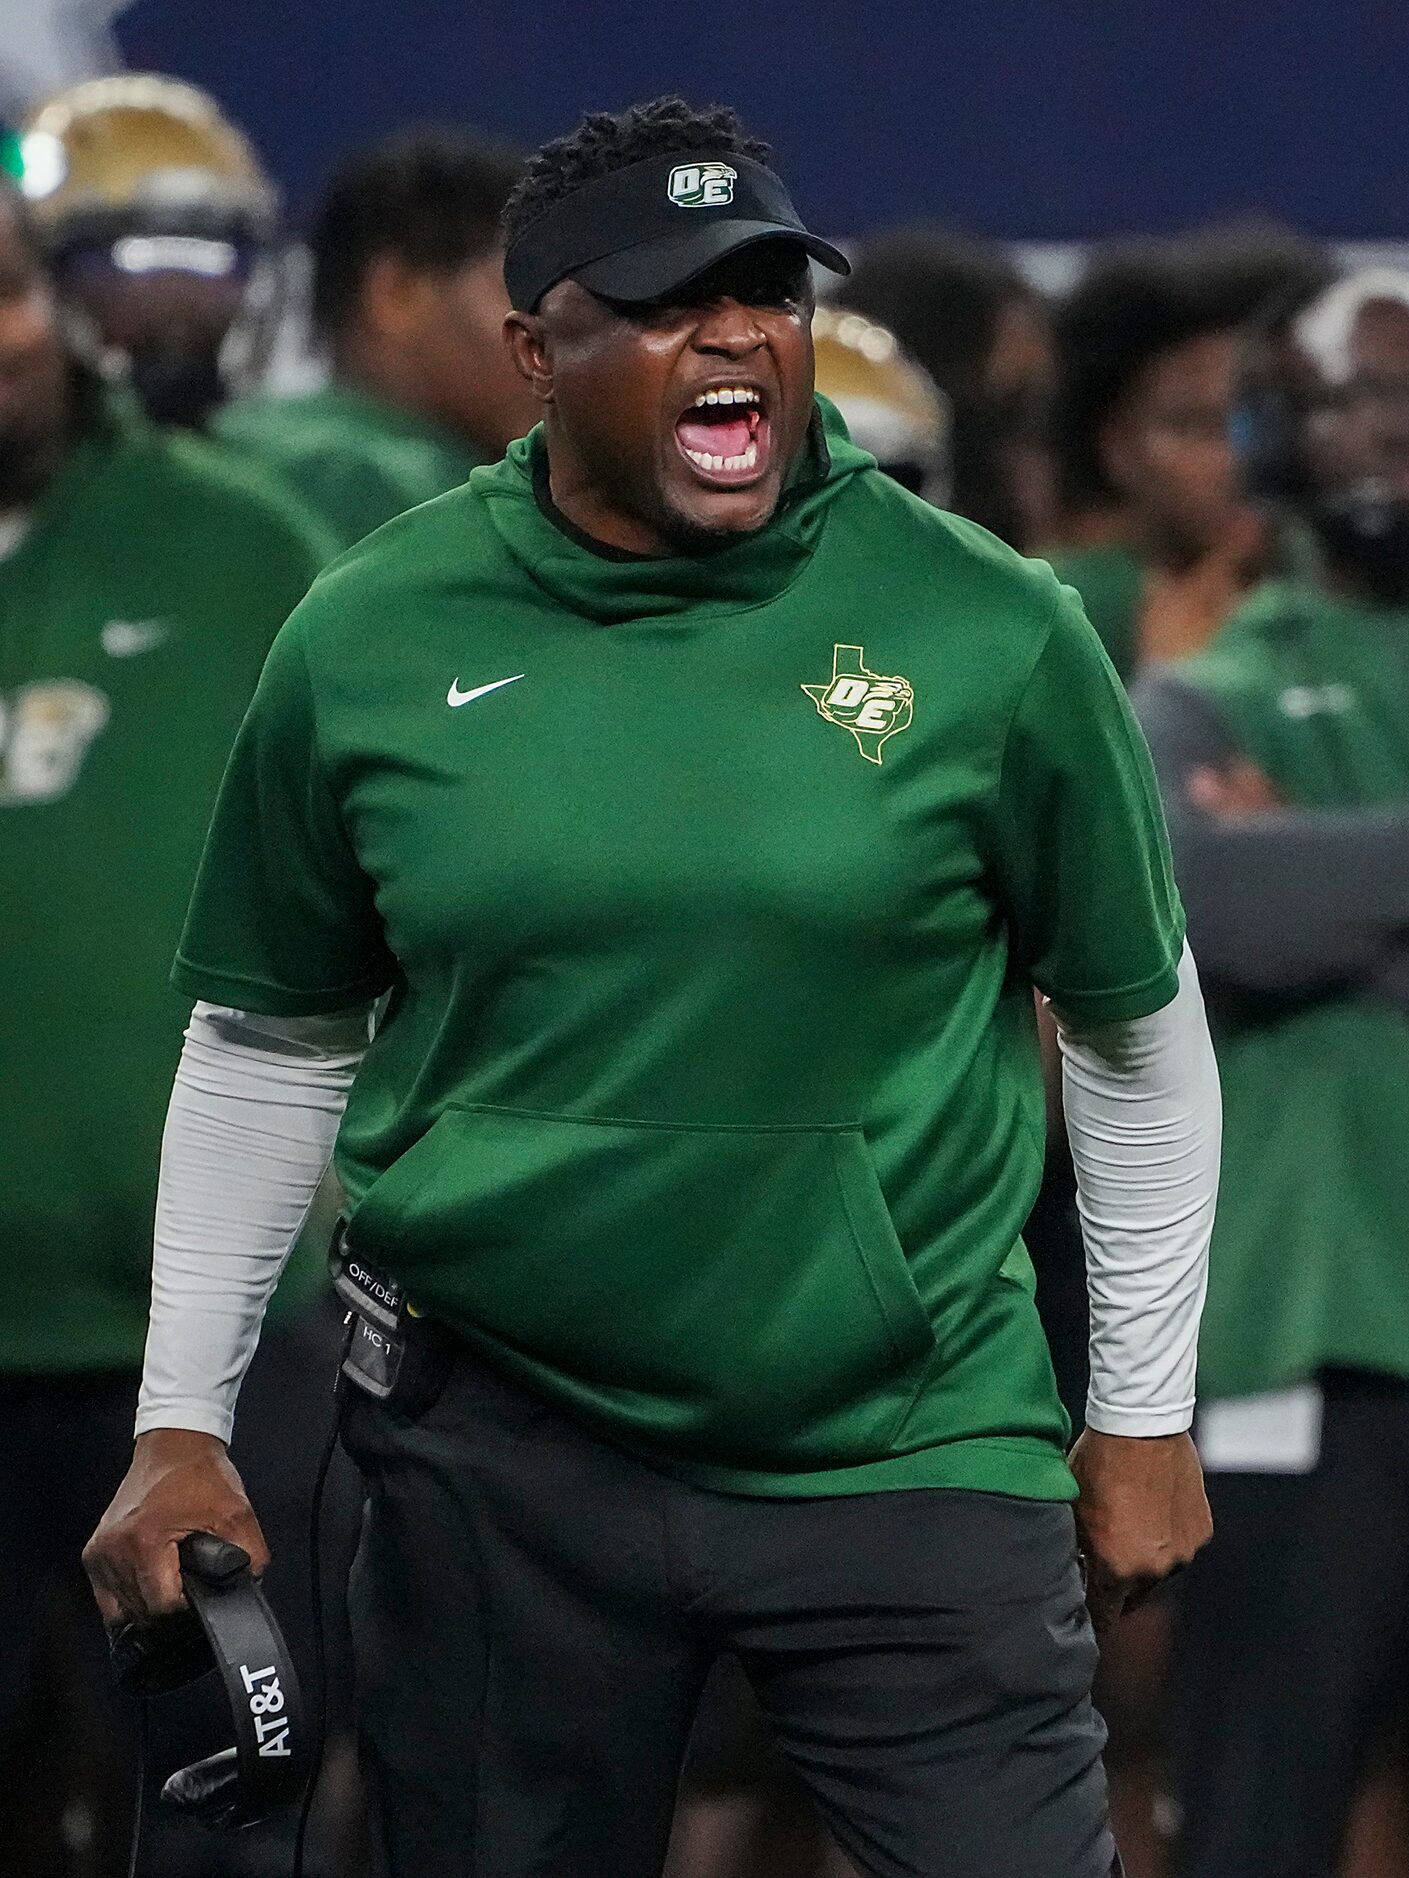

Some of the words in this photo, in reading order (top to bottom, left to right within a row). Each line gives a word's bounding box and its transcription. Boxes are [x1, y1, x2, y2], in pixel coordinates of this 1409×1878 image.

[673, 168, 728, 204] DE
[826, 678, 896, 729] DE
[349, 1263, 399, 1307] OFF/DEF
[363, 1326, 382, 1347] HC
[385, 1343, 391, 1355] 1
[240, 1665, 291, 1757] AT&T
